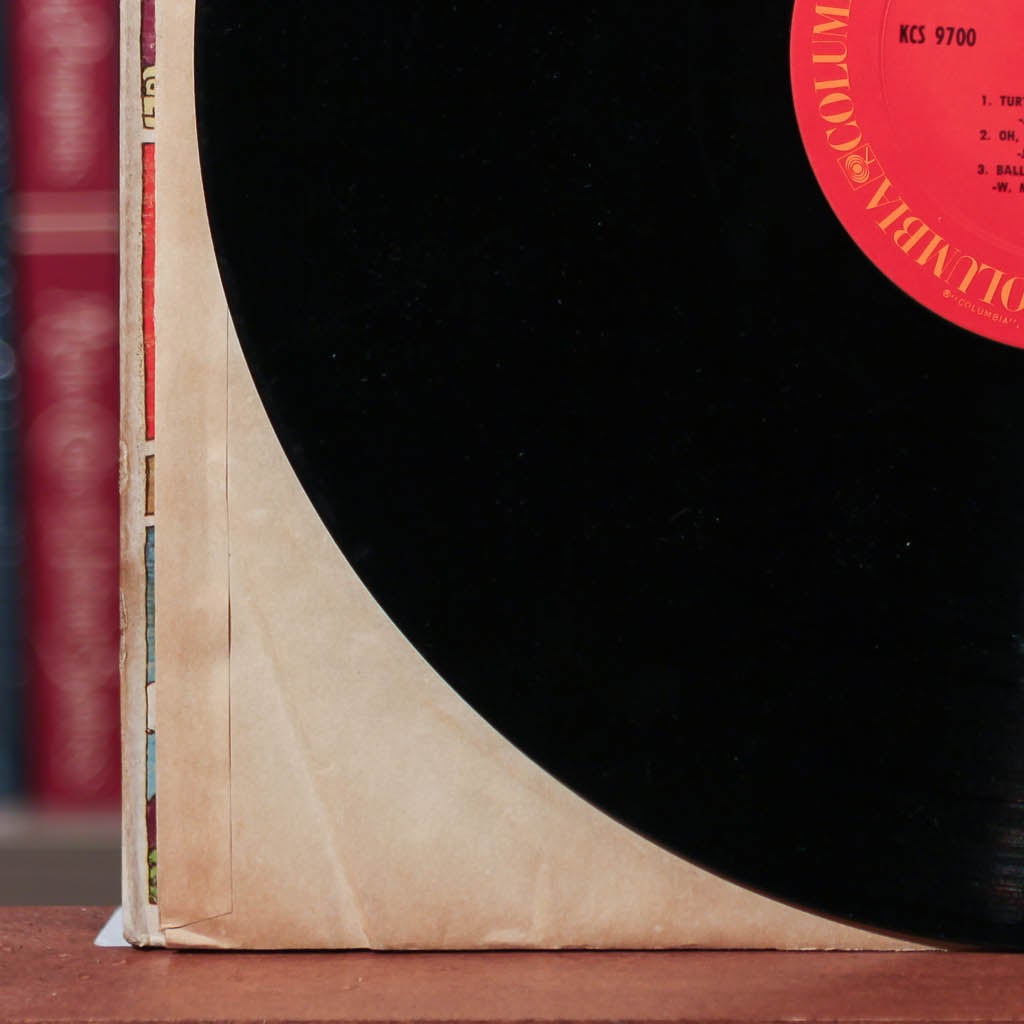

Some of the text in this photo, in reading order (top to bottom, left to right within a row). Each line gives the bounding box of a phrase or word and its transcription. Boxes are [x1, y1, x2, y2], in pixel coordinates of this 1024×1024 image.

[898, 24, 977, 47] KCS 9700
[999, 130, 1019, 143] OH,
[996, 164, 1024, 177] BALL
